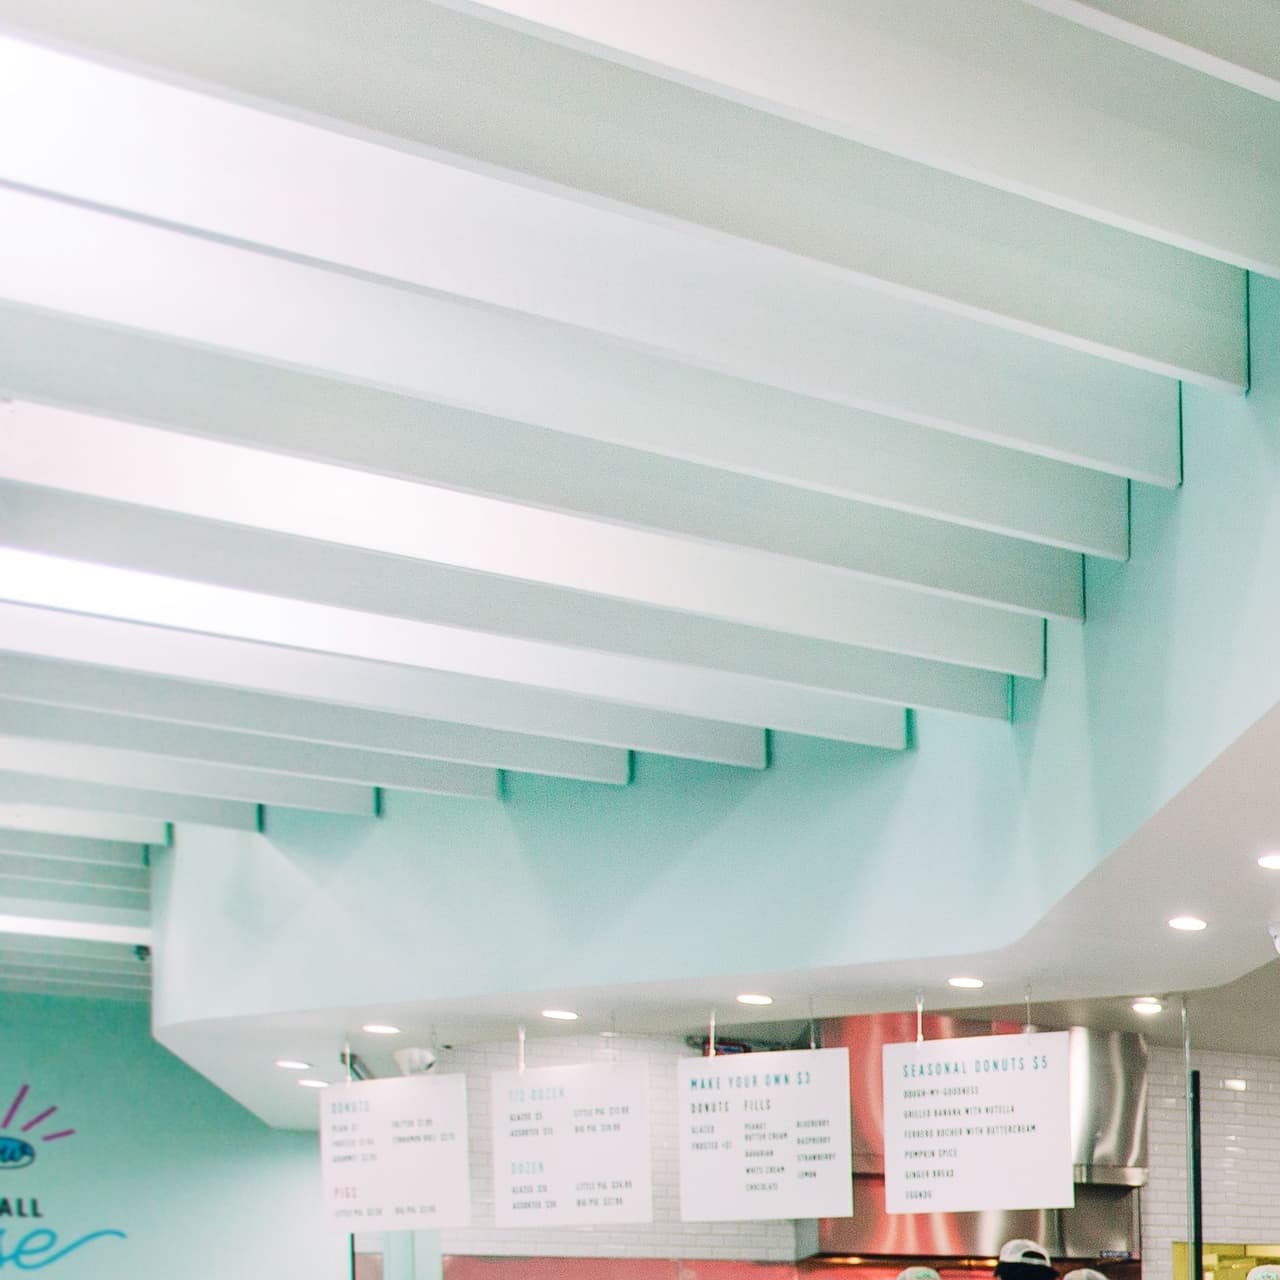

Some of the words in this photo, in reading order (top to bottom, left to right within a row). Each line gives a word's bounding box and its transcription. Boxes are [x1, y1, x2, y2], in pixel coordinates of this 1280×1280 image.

[902, 1061, 967, 1078] SEASONAL
[974, 1056, 1025, 1073] DONUTS
[1032, 1055, 1048, 1070] $5
[690, 1076, 721, 1089] MAKE
[727, 1074, 757, 1088] YOUR
[764, 1073, 790, 1087] OWN
[690, 1101, 730, 1114] DONUTS
[744, 1098, 772, 1112] FILLS
